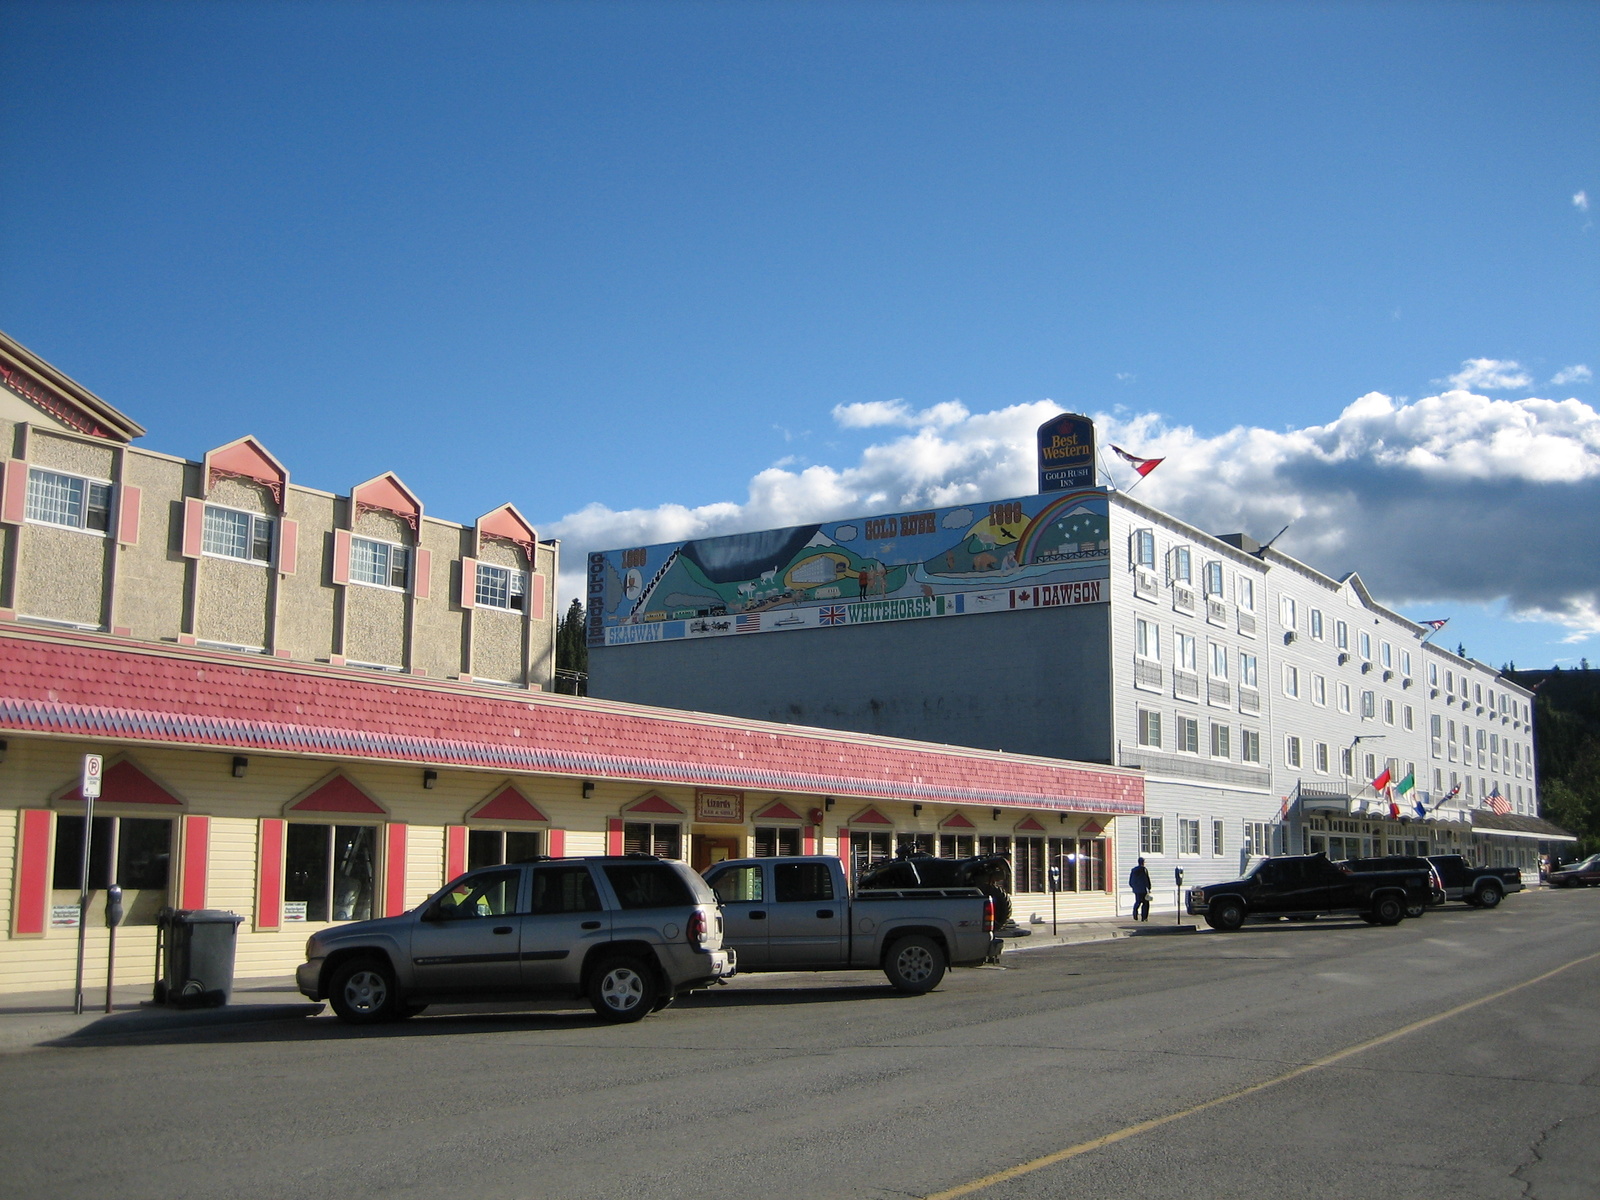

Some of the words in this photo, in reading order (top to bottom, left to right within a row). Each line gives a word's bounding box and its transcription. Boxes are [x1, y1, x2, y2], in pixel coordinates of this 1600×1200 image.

[1052, 433, 1078, 448] Best
[1043, 445, 1089, 460] Western
[1045, 471, 1067, 481] GOLD
[1067, 468, 1089, 478] RUSH
[1060, 479, 1074, 488] INN
[865, 517, 897, 541] GOLD
[900, 512, 936, 537] RUSH
[590, 553, 605, 594] GOLD
[1042, 581, 1101, 606] DAWSON
[589, 597, 604, 636] RUSH
[847, 597, 932, 623] WHITEHORSE
[610, 623, 659, 644] SKAGWAY
